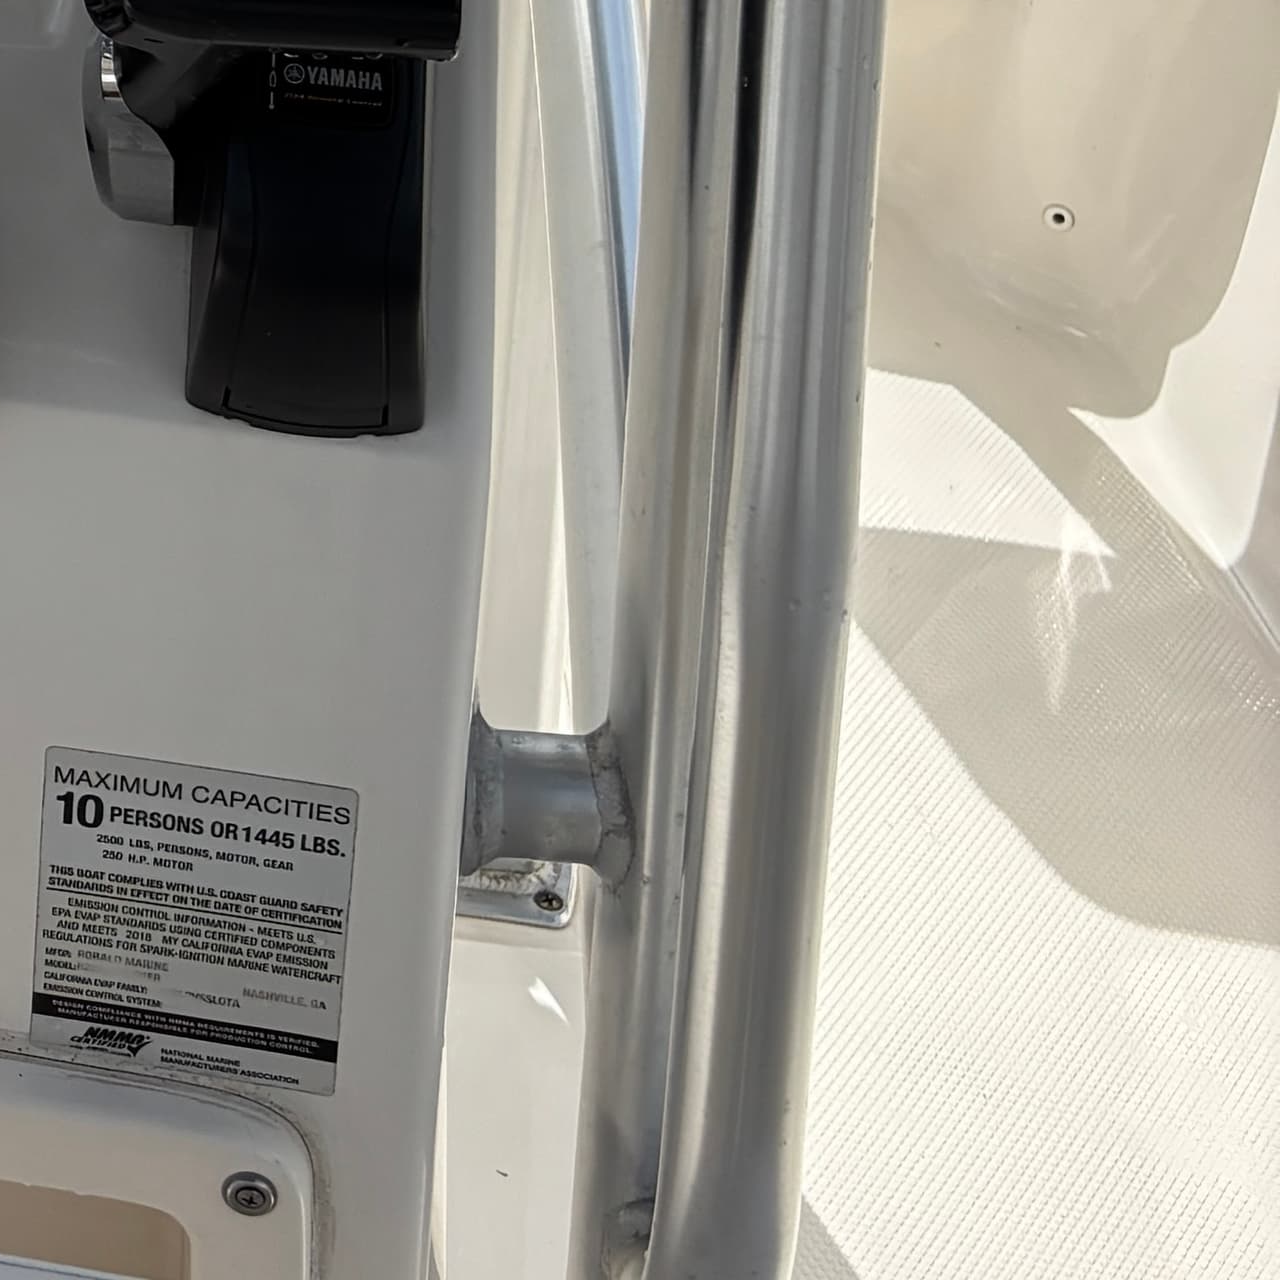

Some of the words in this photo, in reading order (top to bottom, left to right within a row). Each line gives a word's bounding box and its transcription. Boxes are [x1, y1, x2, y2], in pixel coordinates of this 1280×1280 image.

[307, 65, 383, 91] YAMAHA
[53, 765, 183, 801] MAXIMUM
[190, 784, 351, 826] CAPACITIES
[54, 789, 105, 830] 10
[109, 805, 204, 836] PERSONS
[210, 820, 239, 841] OR
[242, 824, 295, 850] 1445
[300, 833, 346, 857] LBS.
